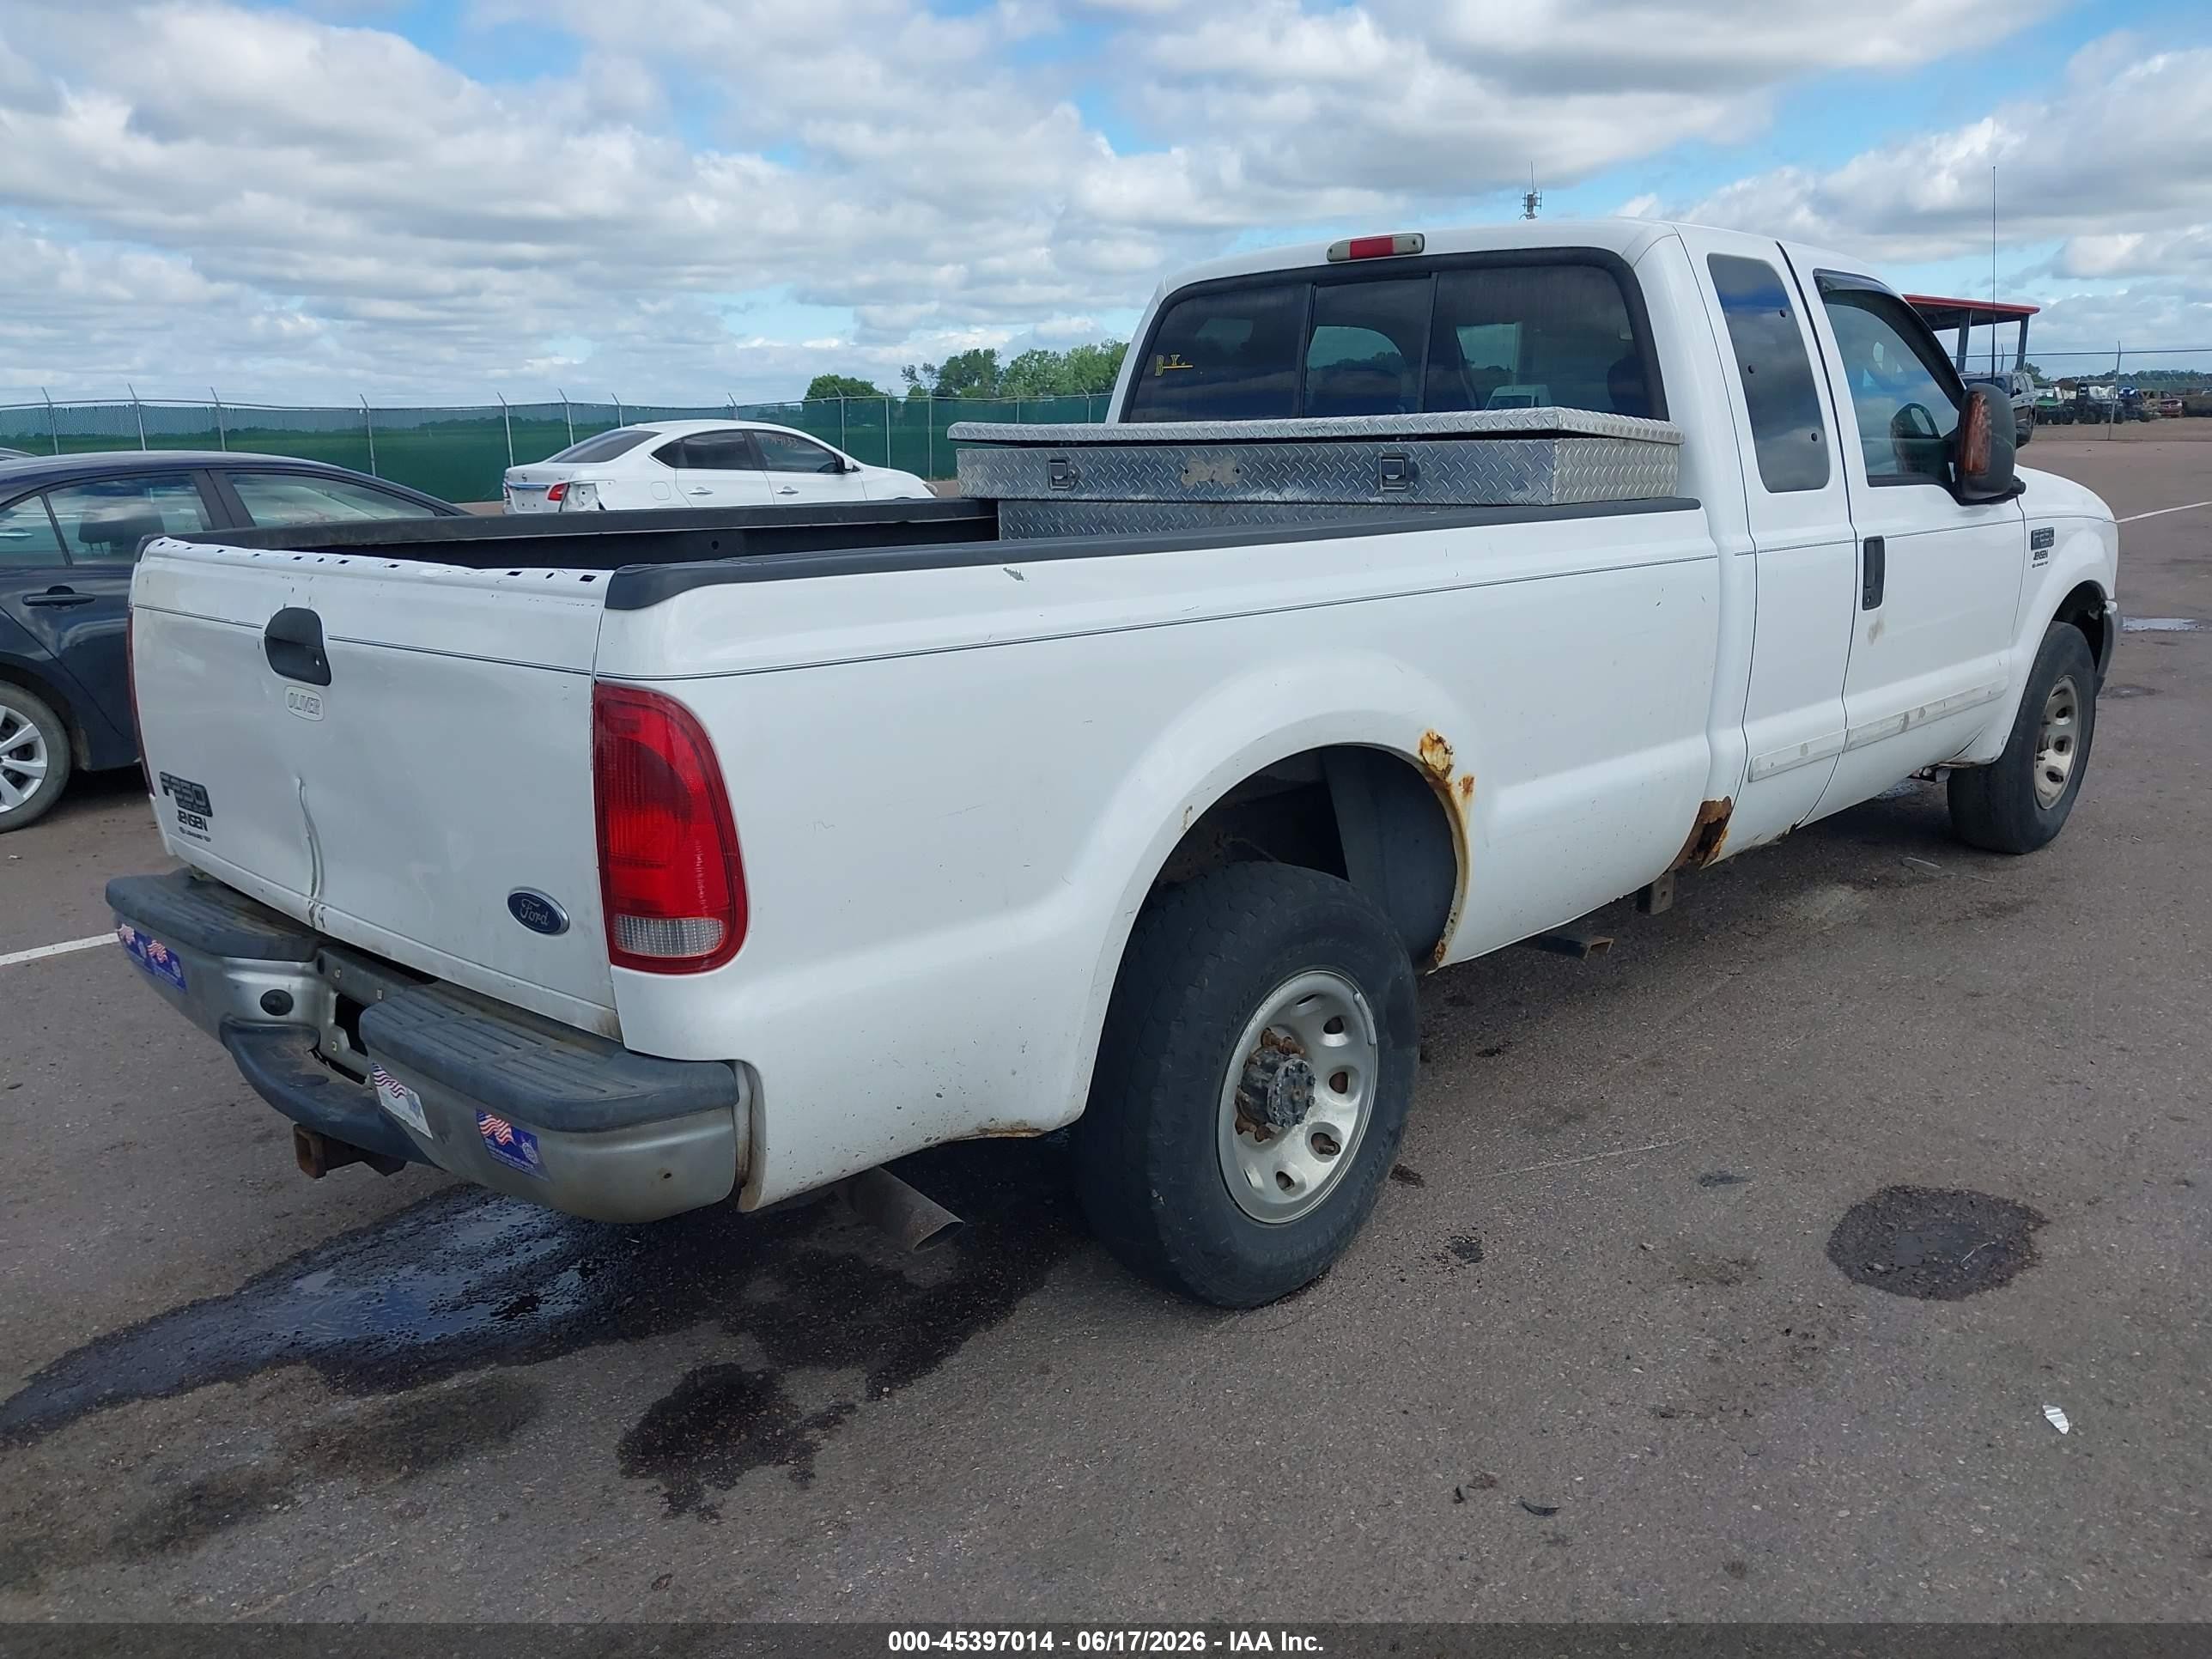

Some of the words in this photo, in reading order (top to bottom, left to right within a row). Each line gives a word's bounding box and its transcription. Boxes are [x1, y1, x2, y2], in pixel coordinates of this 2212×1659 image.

[288, 692, 321, 715] OLIVER
[177, 810, 209, 832] JENSEN
[519, 898, 550, 927] Ford
